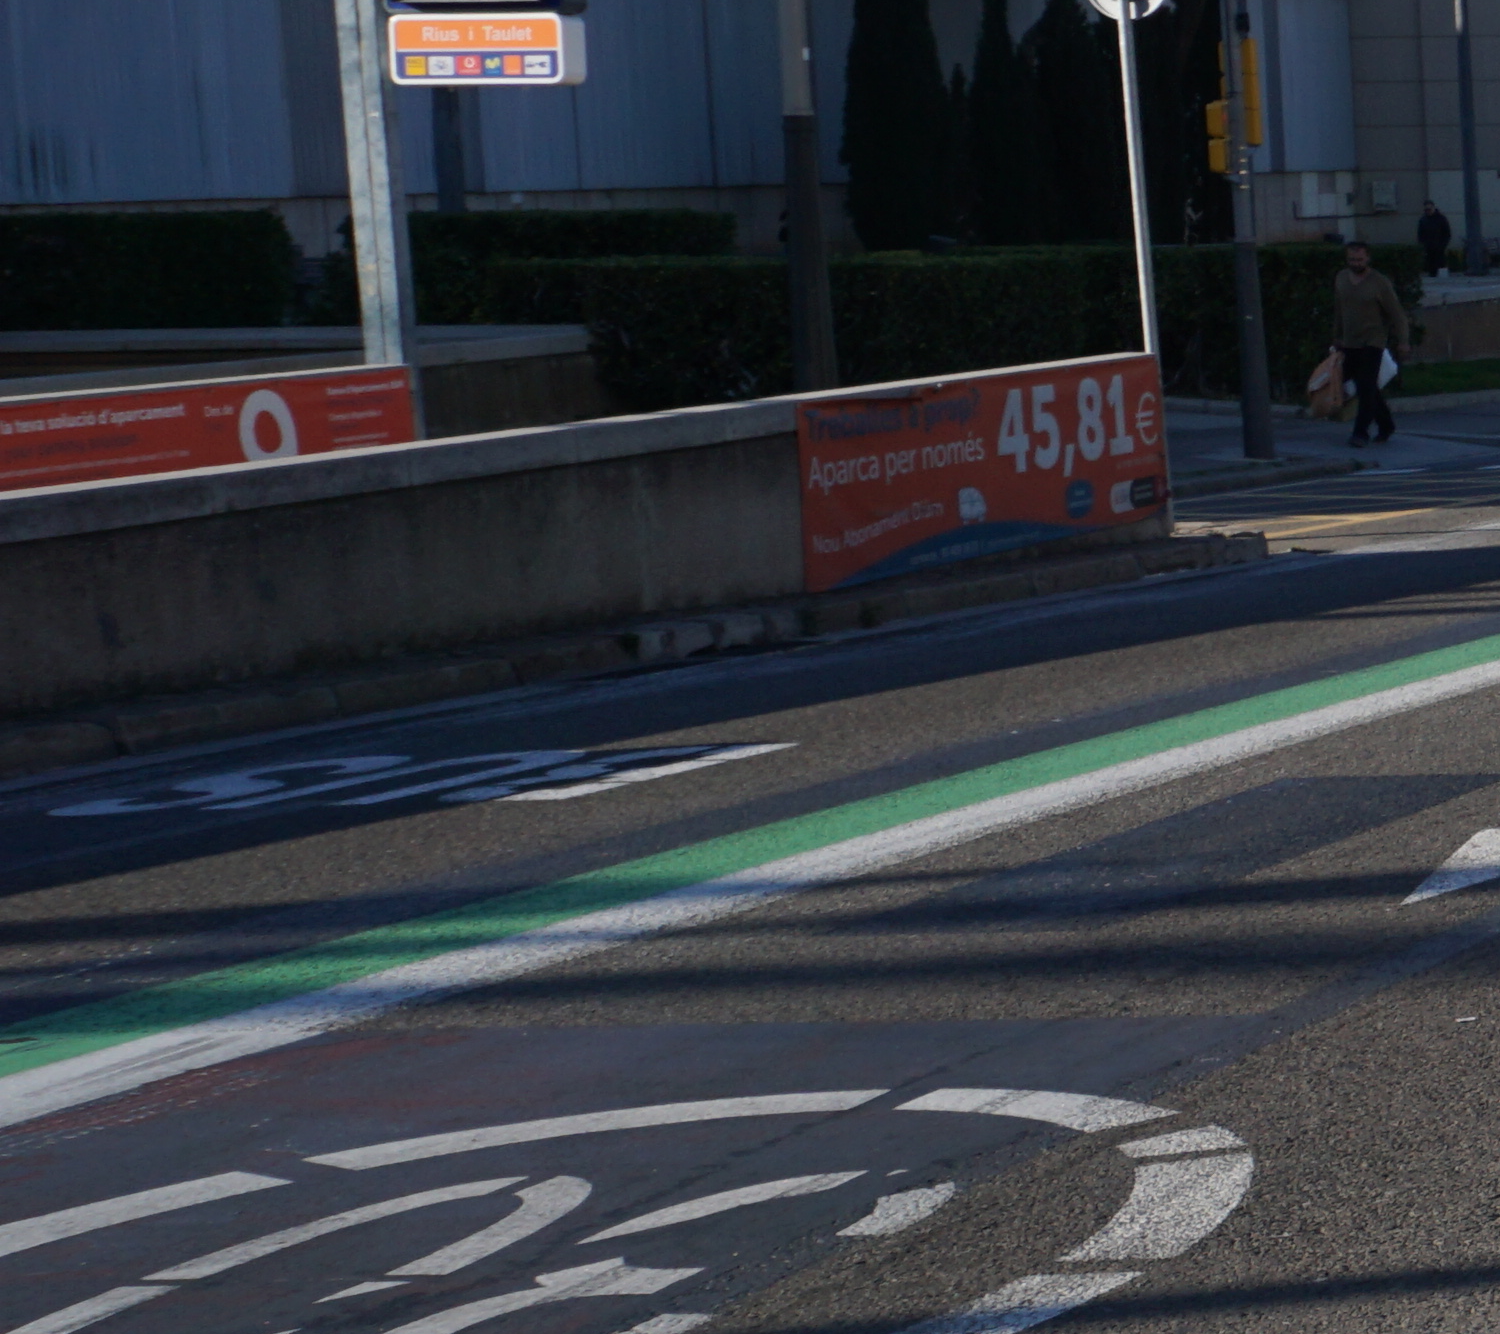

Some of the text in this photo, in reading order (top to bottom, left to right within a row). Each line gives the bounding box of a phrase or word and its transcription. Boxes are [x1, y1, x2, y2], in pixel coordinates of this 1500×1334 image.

[421, 24, 533, 42] Rius i Taulet
[808, 456, 880, 496] Aparca
[885, 450, 916, 485] per
[921, 431, 985, 470] només
[997, 374, 1134, 477] 45,81
[1135, 392, 1158, 445] €
[812, 533, 840, 554] Nou
